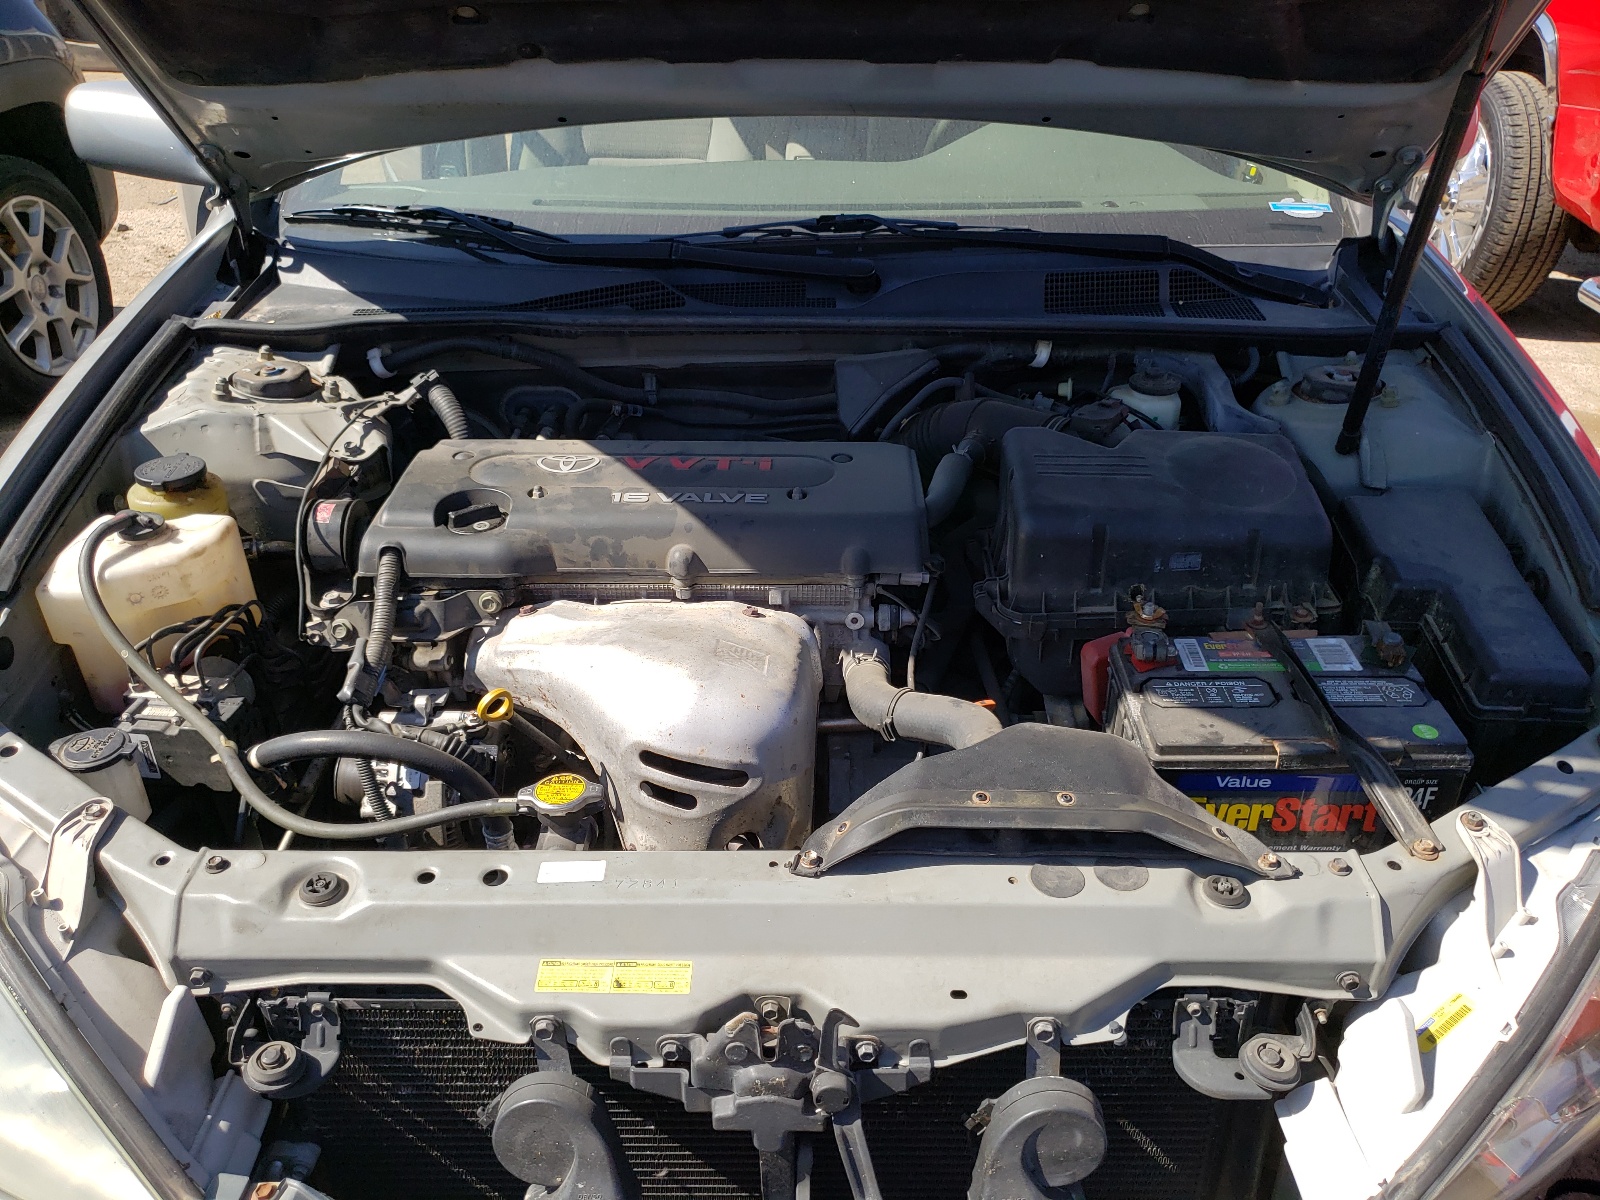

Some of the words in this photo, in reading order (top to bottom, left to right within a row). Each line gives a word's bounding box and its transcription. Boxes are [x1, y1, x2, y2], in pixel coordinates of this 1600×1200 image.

[611, 492, 650, 504] 16
[656, 492, 768, 504] VALVE
[1216, 776, 1272, 788] Value
[1189, 797, 1377, 832] verStart
[1299, 844, 1341, 852] Warranty
